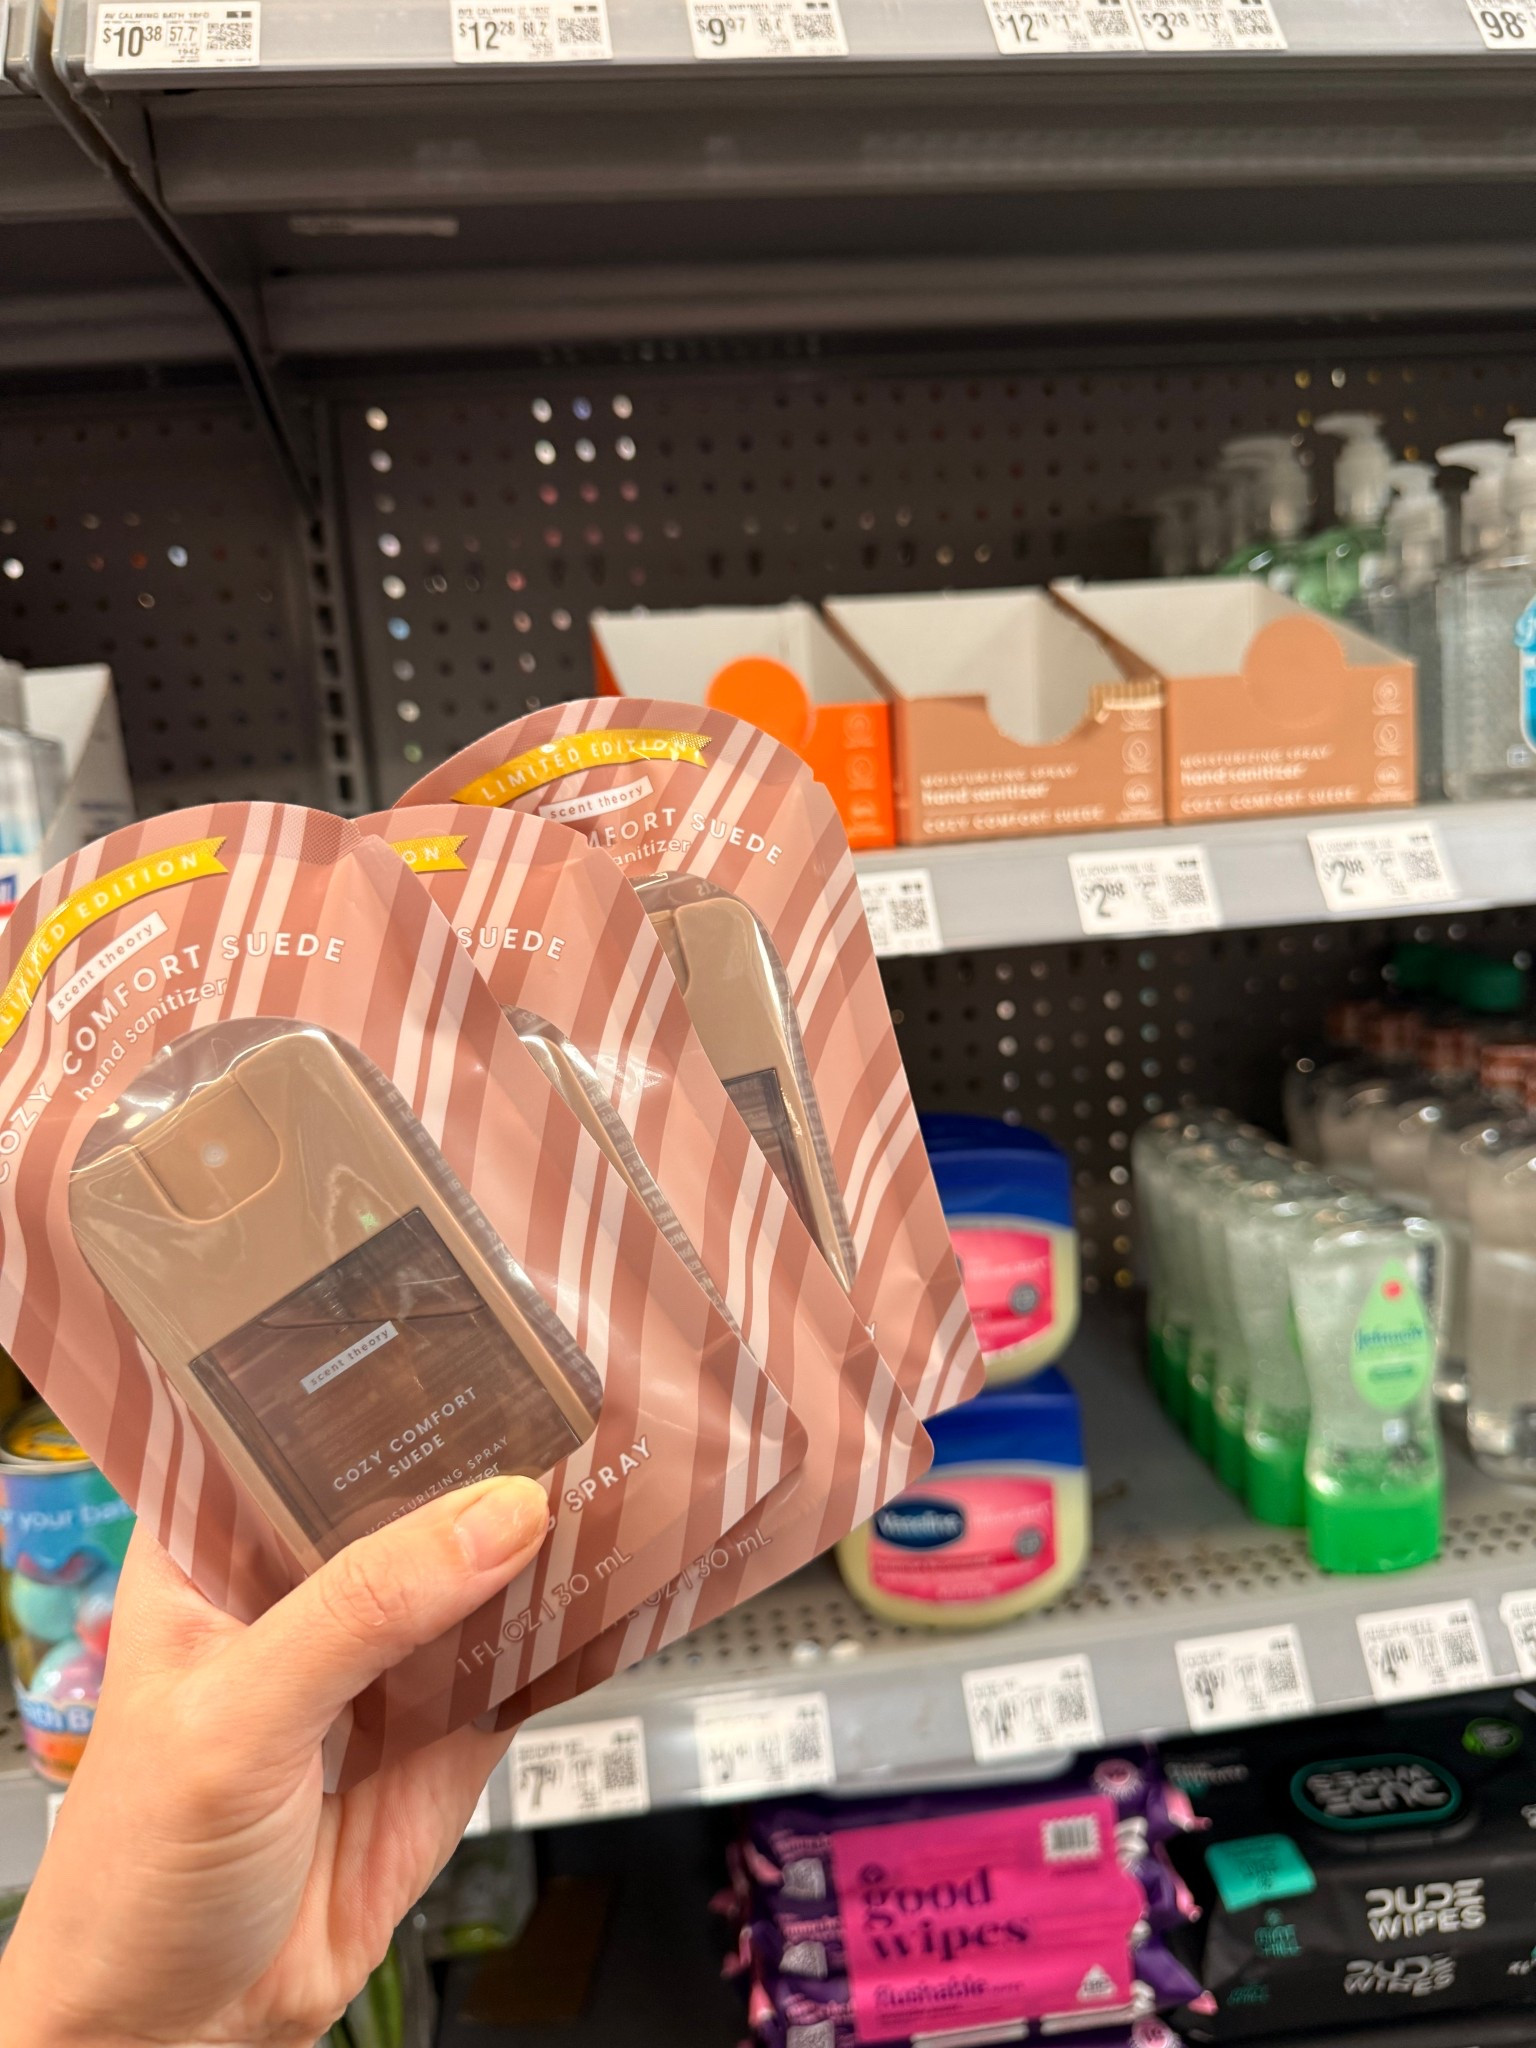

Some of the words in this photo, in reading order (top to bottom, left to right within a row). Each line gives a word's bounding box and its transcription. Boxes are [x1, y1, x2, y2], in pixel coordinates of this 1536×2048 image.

[481, 748, 580, 801] LIMITED
[593, 739, 687, 758] EDITION
[550, 801, 593, 819] scent
[598, 785, 644, 808] theory
[612, 839, 692, 867] anitizer
[691, 812, 782, 865] SUEDE
[75, 851, 199, 919] EDITION
[56, 969, 98, 1010] scent
[98, 922, 155, 970] theory
[456, 926, 566, 961] SUEDE
[61, 944, 202, 1077] COMFORT
[221, 930, 347, 964] SUEDE
[74, 1039, 128, 1102] hand
[126, 977, 229, 1045] sanitizer
[308, 1356, 346, 1388] scent
[346, 1326, 392, 1359] theory
[332, 1448, 384, 1492] COZY
[388, 1386, 478, 1453] COMFORT
[386, 1433, 446, 1480] SUEDE
[466, 1434, 509, 1470] SPRAY
[564, 1435, 652, 1513] SPRAY
[693, 1548, 730, 1579] 30
[735, 1527, 774, 1558] mL
[456, 1657, 472, 1676] 1
[471, 1638, 504, 1666] FL
[503, 1607, 542, 1643] OZ
[553, 1572, 591, 1607] 30
[594, 1545, 634, 1581] mL
[858, 1864, 997, 1932] good
[1364, 1877, 1485, 1919] DUDE
[1368, 1904, 1486, 1942] WIPES
[868, 1914, 1031, 1962] wipes
[1343, 1966, 1456, 1997] WIPES
[1345, 1953, 1456, 1981] DUDE
